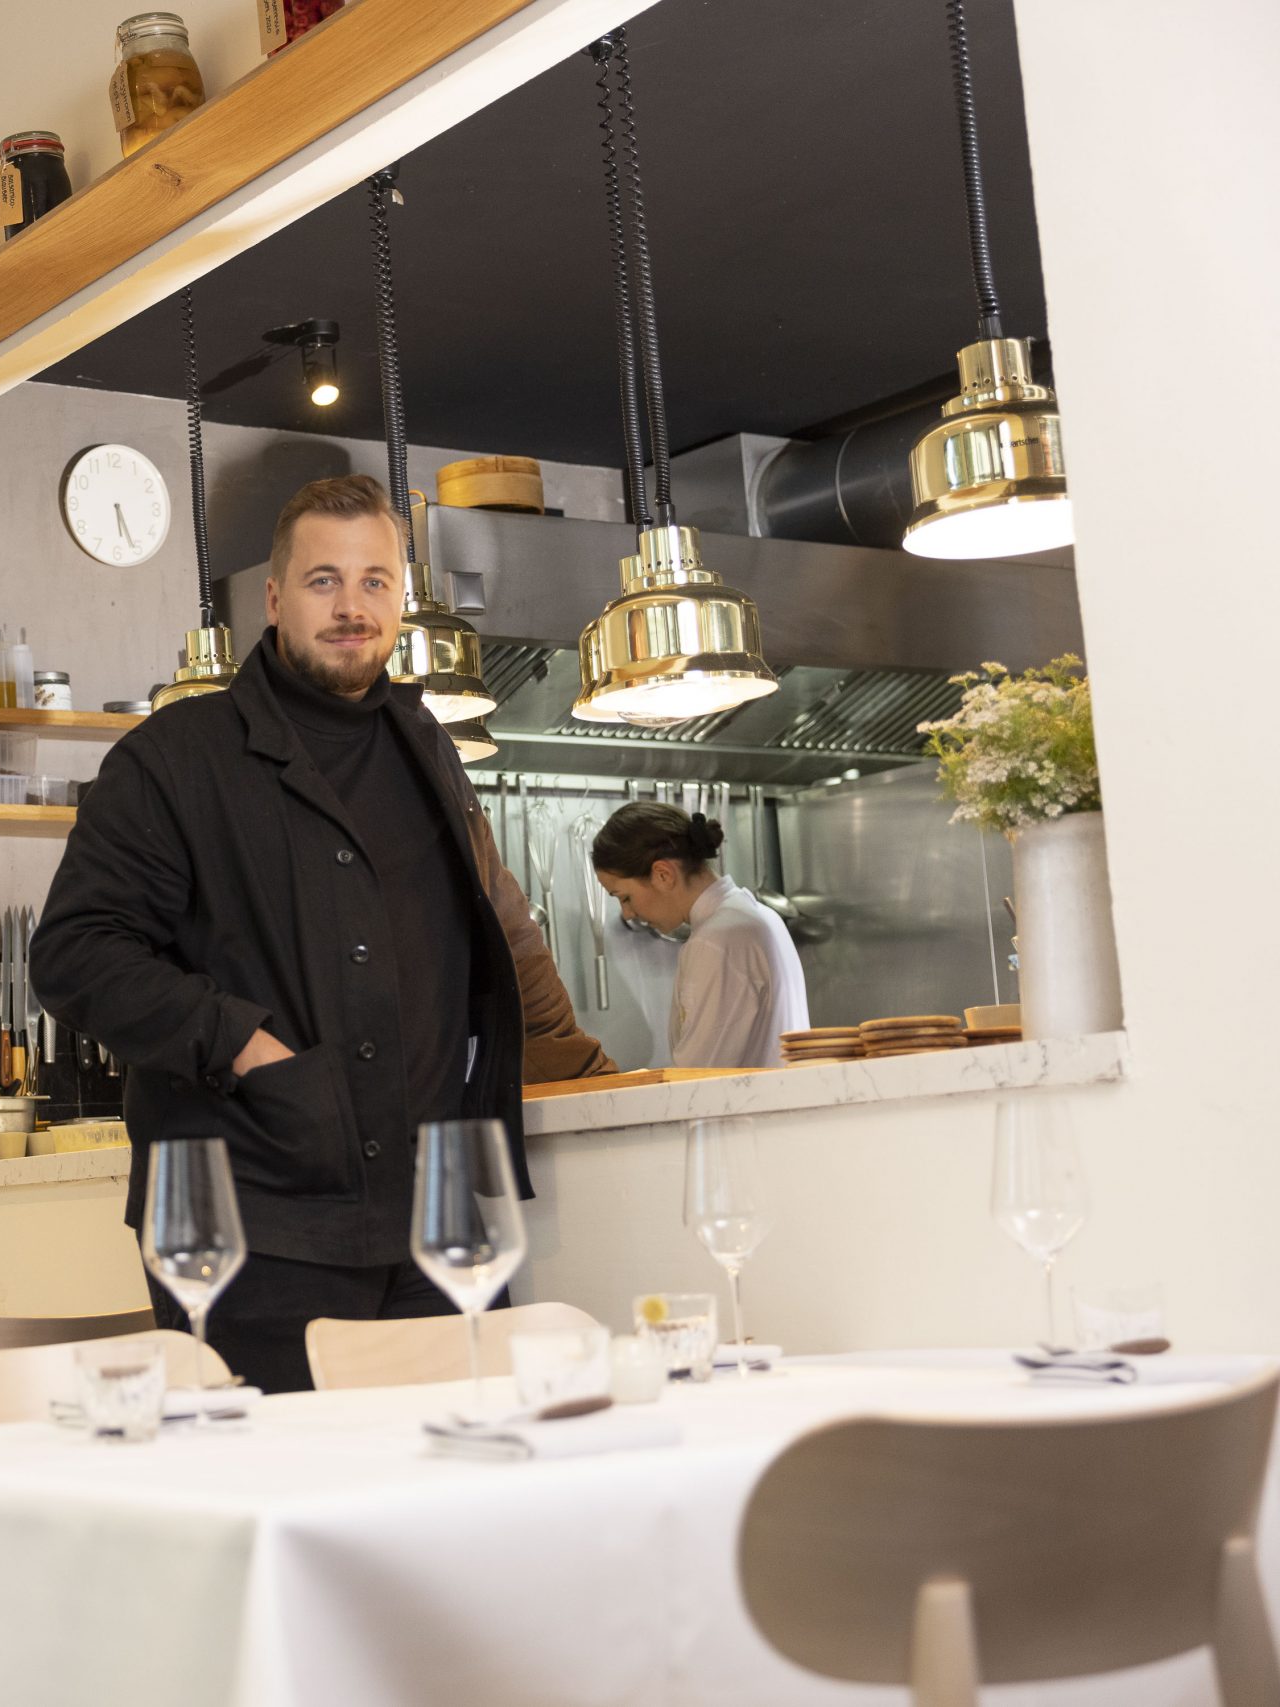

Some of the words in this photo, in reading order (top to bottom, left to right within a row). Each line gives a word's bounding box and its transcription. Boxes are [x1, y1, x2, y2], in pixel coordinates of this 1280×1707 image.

[87, 458, 100, 474] 11
[106, 452, 122, 468] 12
[132, 461, 138, 475] 1
[73, 474, 89, 490] 10
[144, 479, 155, 494] 2
[69, 496, 79, 511] 9
[151, 502, 161, 517] 3
[76, 520, 86, 535] 8
[147, 524, 156, 537] 4
[92, 537, 103, 553] 7
[133, 540, 143, 555] 5
[113, 545, 122, 561] 6
